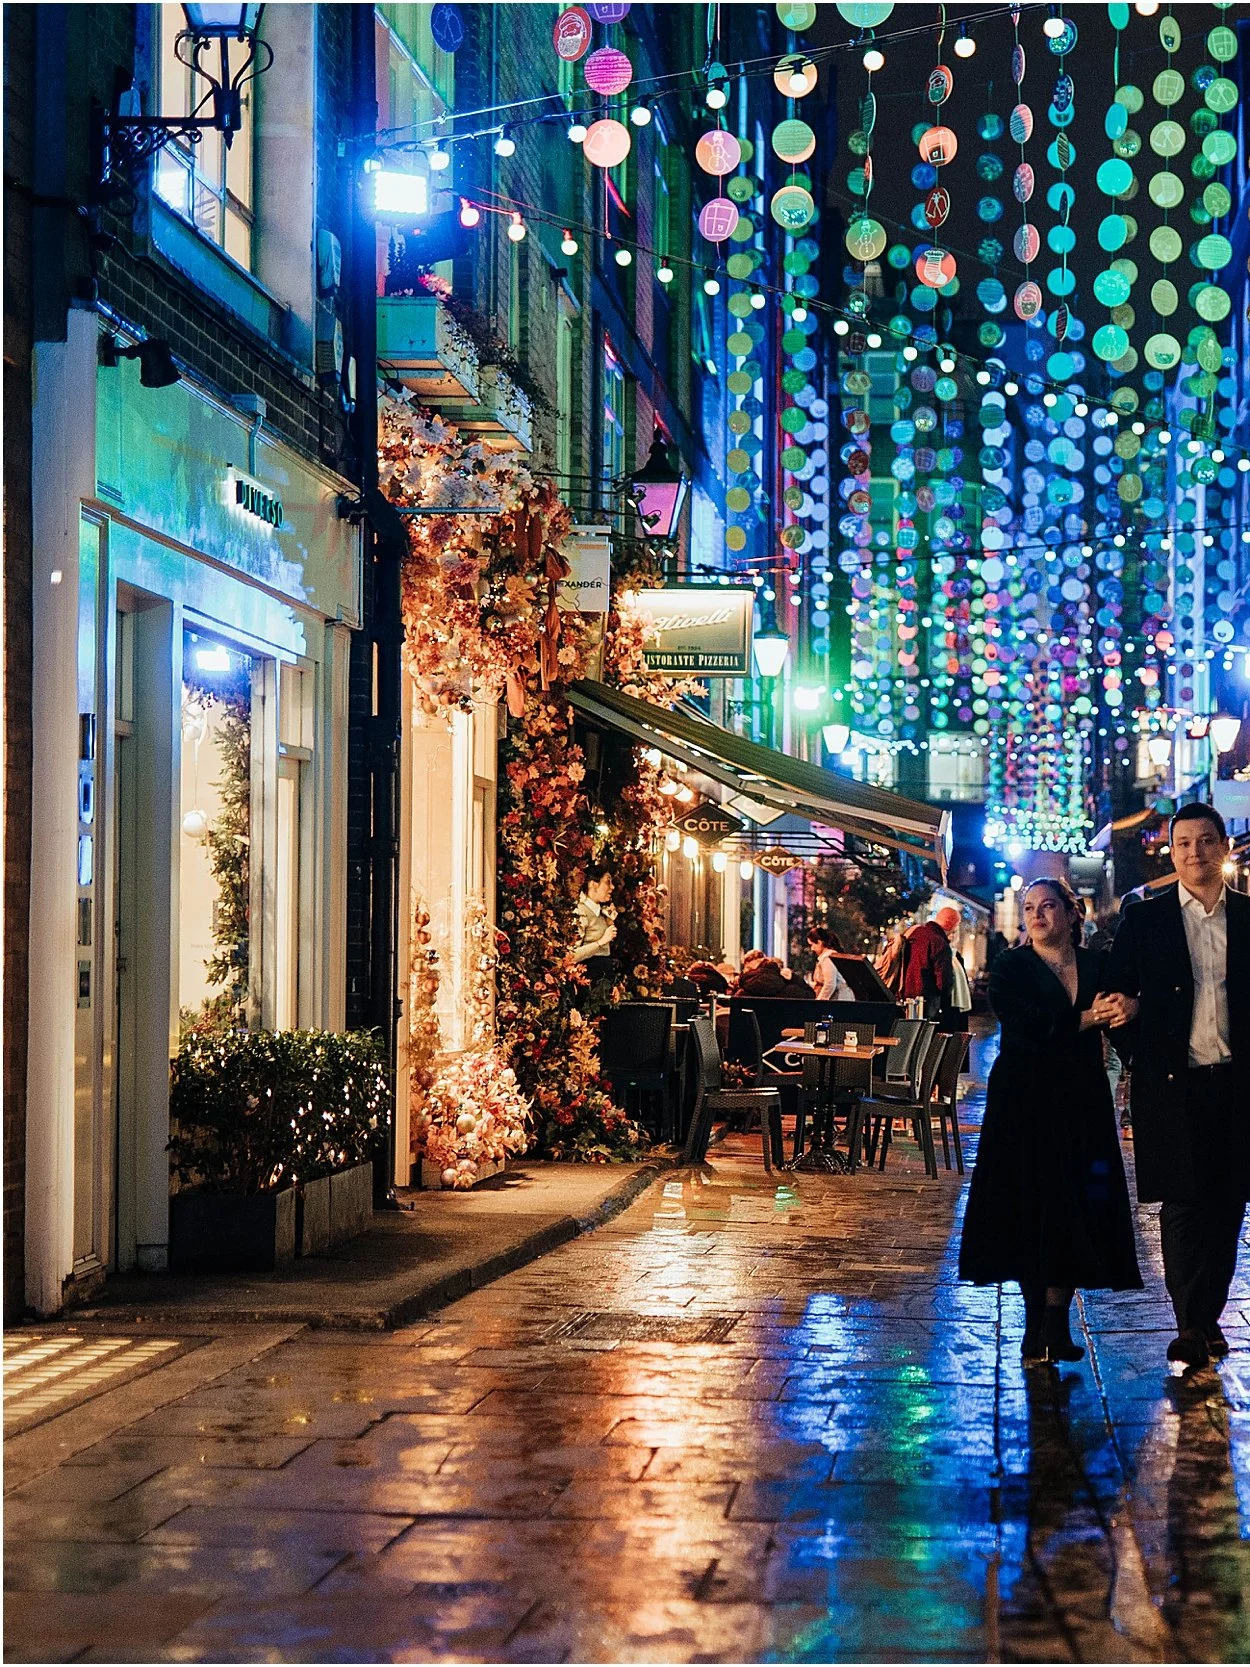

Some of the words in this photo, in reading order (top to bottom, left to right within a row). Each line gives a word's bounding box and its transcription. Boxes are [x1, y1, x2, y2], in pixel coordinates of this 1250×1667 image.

[236, 480, 284, 528] DIVERSO
[683, 817, 730, 832] CÔTE
[761, 855, 794, 867] CÔTE
